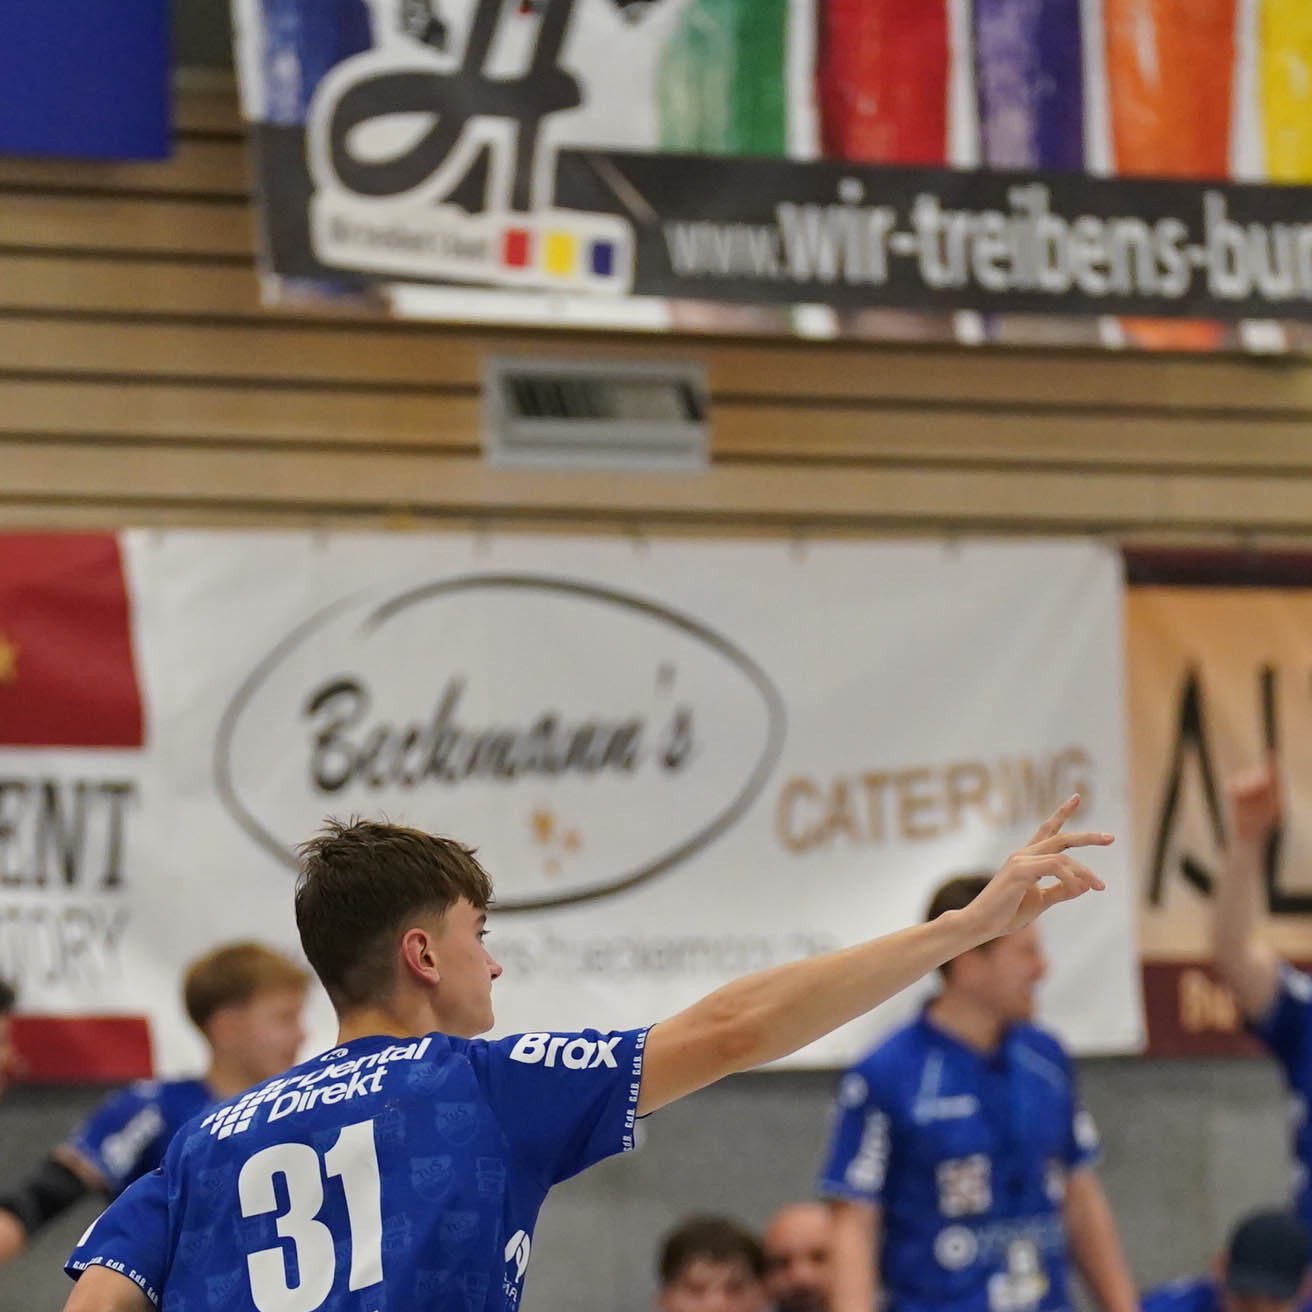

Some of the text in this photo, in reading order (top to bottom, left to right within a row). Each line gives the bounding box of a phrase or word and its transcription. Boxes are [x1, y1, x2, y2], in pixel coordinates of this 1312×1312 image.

[302, 661, 695, 794] Beckmann's
[774, 744, 1093, 855] CATERING
[509, 1031, 623, 1070] Brax
[267, 1066, 388, 1123] Direkt
